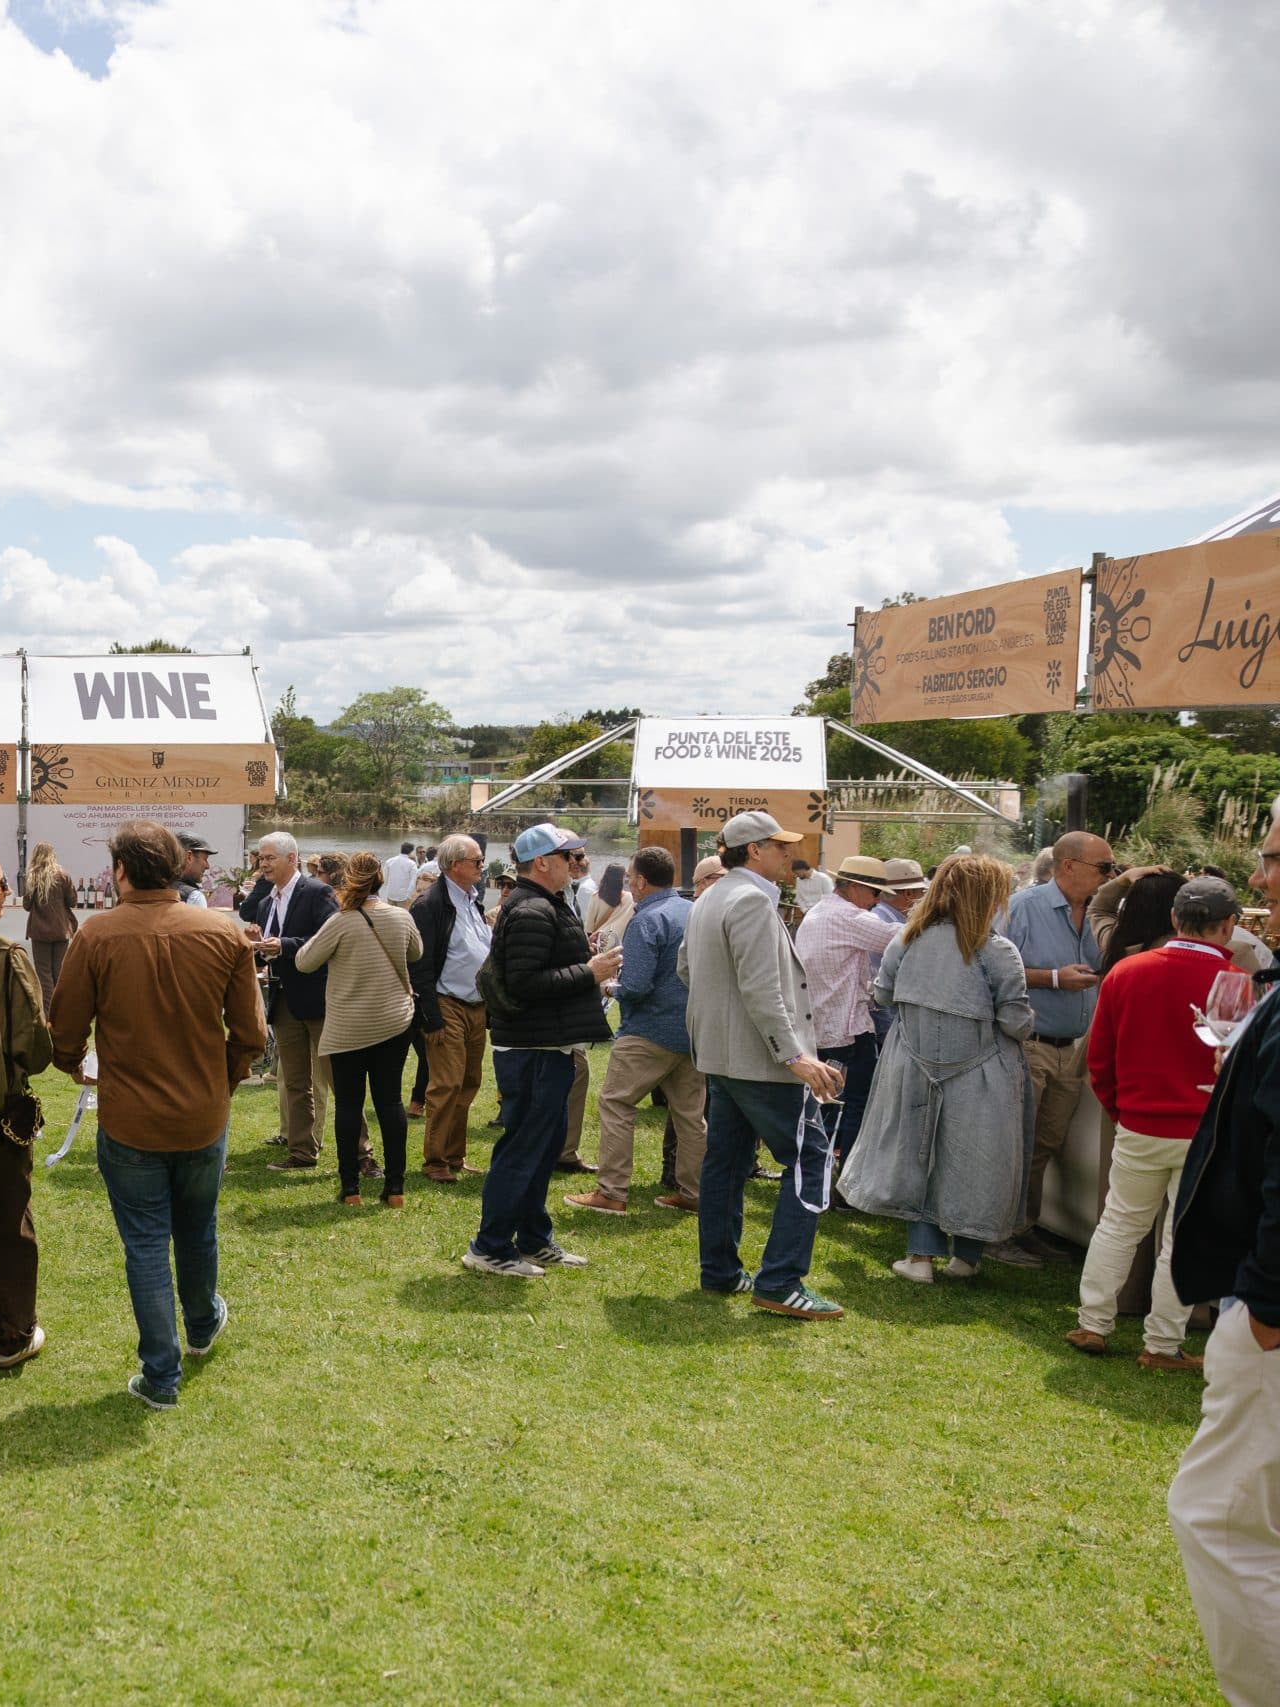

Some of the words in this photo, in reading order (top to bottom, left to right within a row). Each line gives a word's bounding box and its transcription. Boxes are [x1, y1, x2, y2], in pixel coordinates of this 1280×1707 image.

[928, 613, 954, 643] BEN
[956, 606, 995, 638] FORD
[1178, 577, 1280, 690] Luig
[922, 671, 965, 694] FABRIZIO
[966, 666, 1007, 690] SERGIO
[73, 671, 218, 720] WINE
[668, 731, 720, 746] PUNTA
[723, 731, 752, 745] DEL
[755, 731, 791, 746] ESTE
[655, 745, 701, 760] FOOD
[704, 746, 713, 759] &
[716, 744, 757, 760] WINE
[760, 746, 802, 763] 2025
[95, 776, 158, 788] GIMENEZ
[163, 776, 221, 788] MENDEZ
[728, 797, 769, 806] TIENDA
[88, 812, 128, 820] AHUMADO
